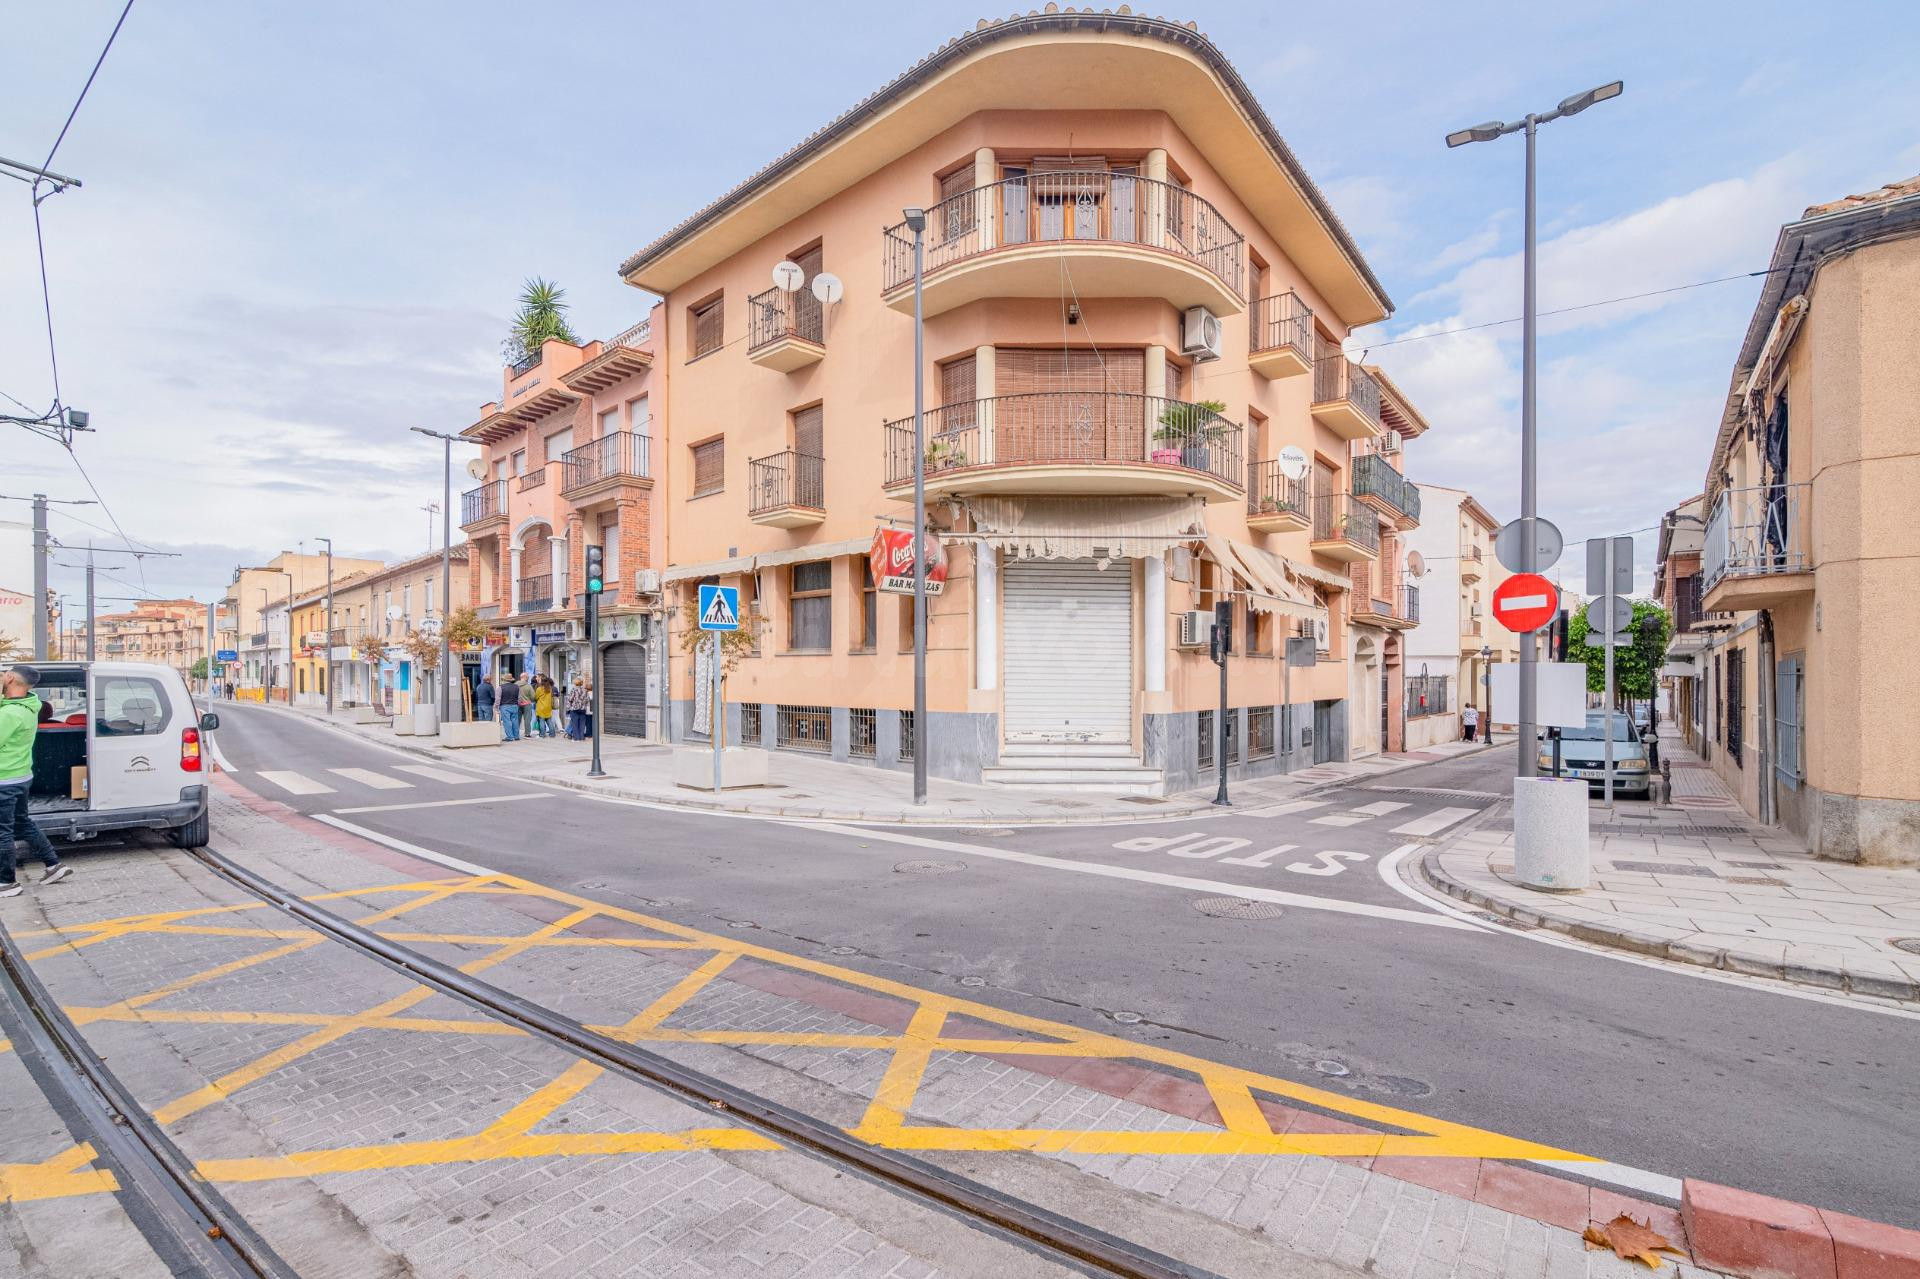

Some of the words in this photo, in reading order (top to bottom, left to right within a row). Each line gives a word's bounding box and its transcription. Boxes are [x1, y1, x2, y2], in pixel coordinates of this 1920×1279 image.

[888, 578, 905, 588] BAR
[905, 580, 940, 592] MAZAS
[1112, 832, 1371, 876] STOP
